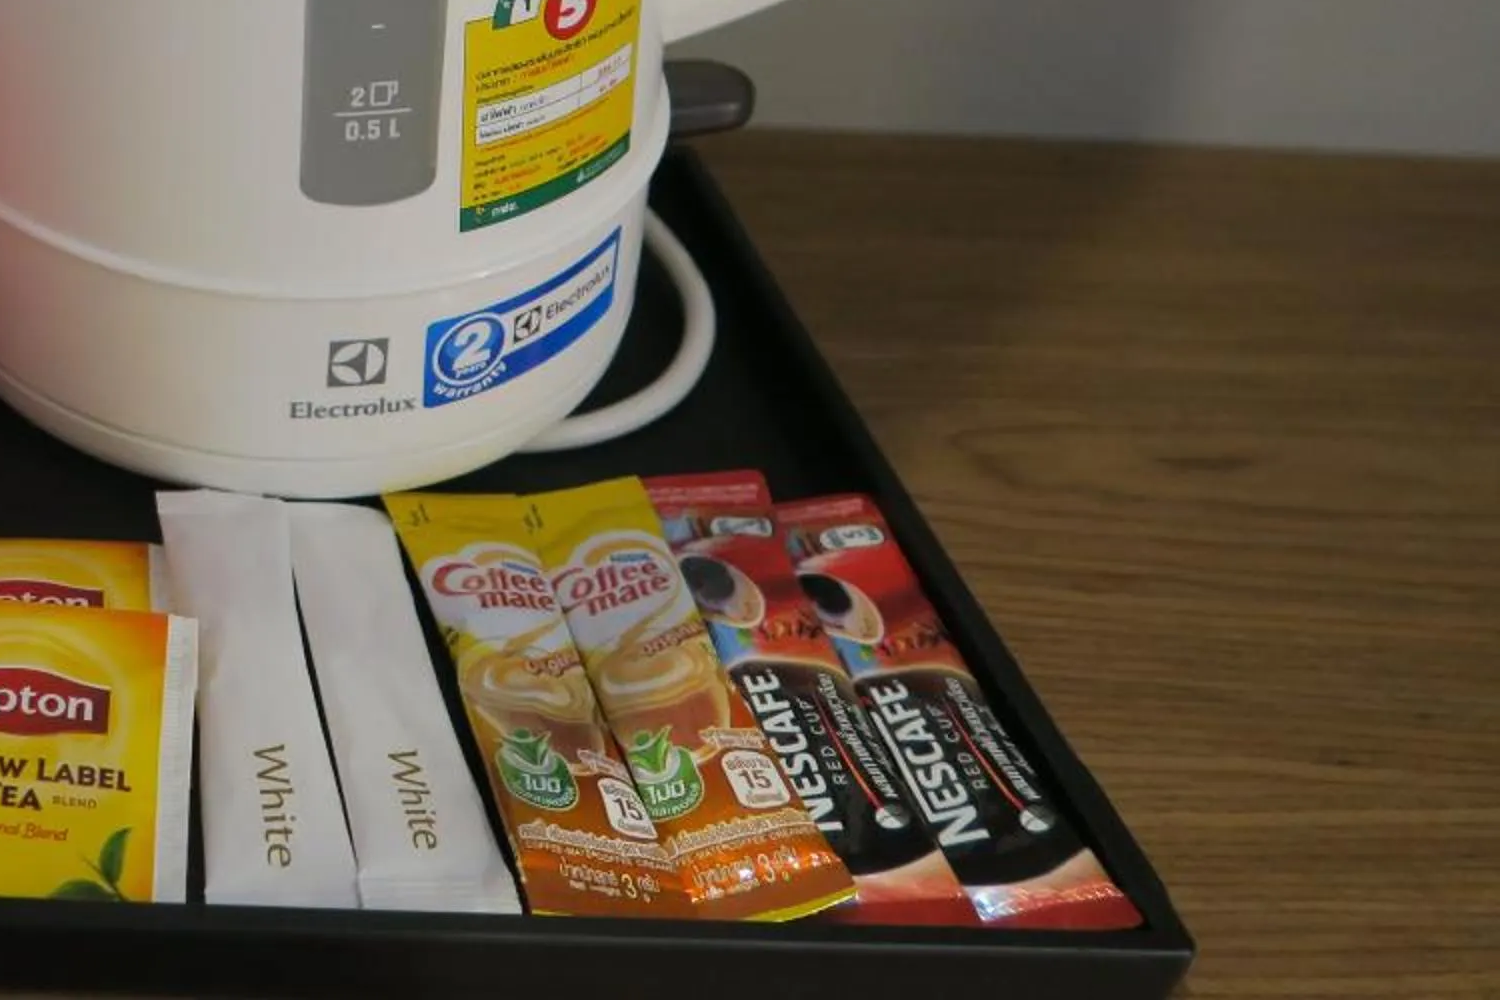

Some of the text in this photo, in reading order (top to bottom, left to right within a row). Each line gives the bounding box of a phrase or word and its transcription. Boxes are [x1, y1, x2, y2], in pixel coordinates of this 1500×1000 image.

[350, 87, 366, 108] 2
[344, 118, 401, 142] 0.5 L
[544, 263, 610, 321] Electrolux
[452, 320, 492, 371] 2
[289, 398, 416, 420] Electrolux
[432, 562, 547, 597] Coffee
[552, 561, 660, 613] Coffee
[588, 574, 671, 616] mate
[478, 591, 556, 612] mate
[799, 701, 849, 785] RED CUP
[930, 708, 990, 789] RED CUP
[36, 757, 132, 792] LABEL
[739, 769, 772, 790] 15
[51, 796, 98, 811] BLEND
[252, 743, 295, 869] White
[387, 749, 439, 851] White
[613, 796, 643, 822] 15
[22, 820, 70, 843] Blend
[757, 852, 775, 883] 3
[620, 873, 637, 900] 3
